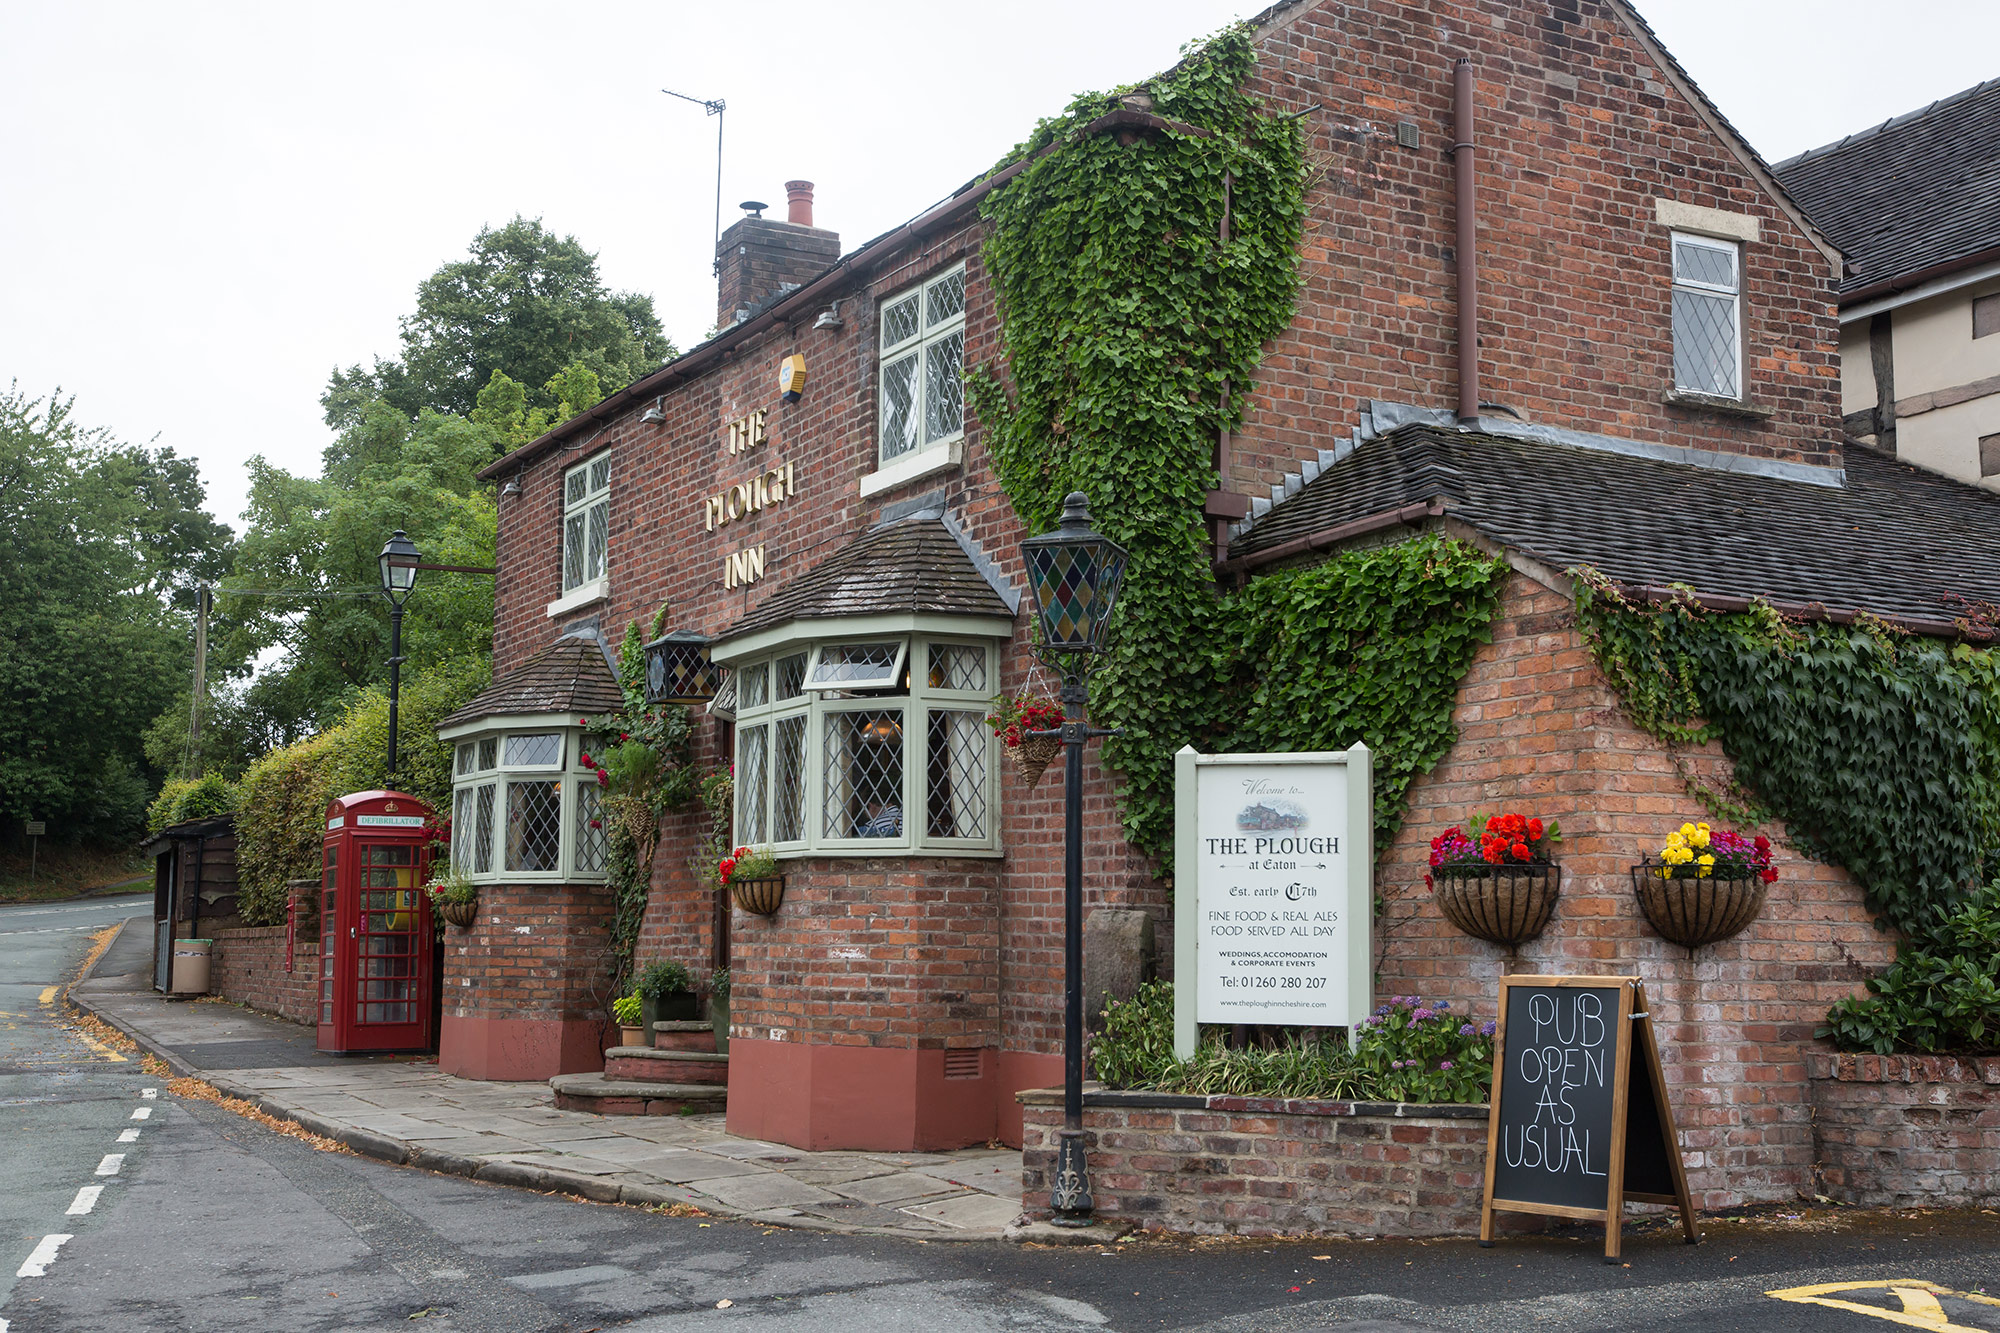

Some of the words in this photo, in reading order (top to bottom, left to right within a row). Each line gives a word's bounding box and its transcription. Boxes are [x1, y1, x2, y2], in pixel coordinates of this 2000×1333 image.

[728, 408, 768, 456] THE
[705, 460, 795, 532] PLOUGH
[724, 543, 765, 590] INN
[1242, 778, 1285, 795] Welcome
[361, 817, 420, 825] DEFIBRILLATOR
[1205, 838, 1247, 855] THE
[1255, 837, 1341, 855] PLOUGH
[1248, 860, 1260, 871] at
[1262, 858, 1297, 871] Eaton
[1229, 886, 1250, 897] Est.
[1253, 887, 1279, 897] early
[1208, 911, 1231, 921] FINE
[1234, 911, 1267, 921] FOOD
[1270, 911, 1279, 921] &
[1282, 911, 1309, 921] REAL
[1313, 911, 1338, 921] ALES
[1211, 925, 1243, 936] FOOD
[1247, 925, 1286, 936] SERVED
[1289, 926, 1309, 936] ALL
[1313, 926, 1336, 936] DAY
[1220, 976, 1239, 988] Tel:
[1241, 976, 1277, 988] 01260
[1281, 977, 1302, 988] 280
[1306, 977, 1327, 988] 207
[1220, 999, 1327, 1009] www.theploughinncheshire.com
[1528, 993, 1605, 1047] PUB
[1520, 1046, 1605, 1087] OPEN
[1534, 1084, 1576, 1125] AS
[1505, 1124, 1607, 1176] USUAL
